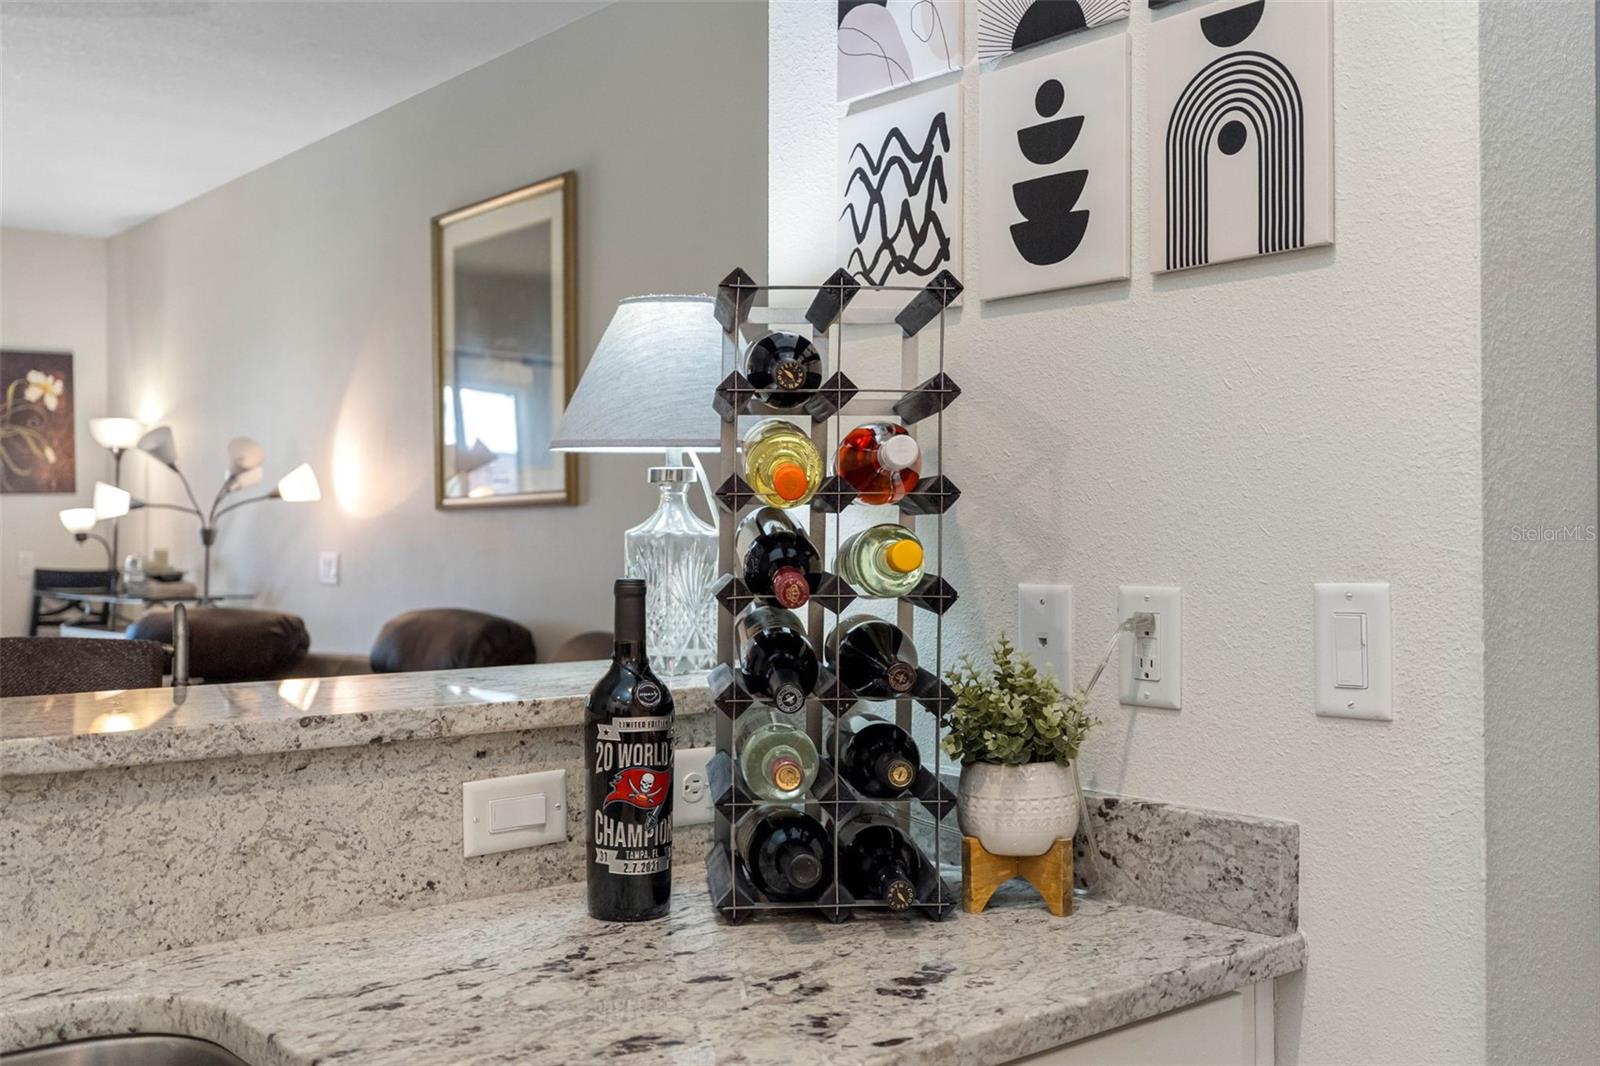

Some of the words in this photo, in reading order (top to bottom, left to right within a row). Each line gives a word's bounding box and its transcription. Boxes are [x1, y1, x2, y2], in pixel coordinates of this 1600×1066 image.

[618, 721, 647, 729] LIMITED
[595, 741, 613, 774] 20
[618, 741, 668, 769] WORLD
[599, 850, 608, 862] 31
[652, 848, 659, 858] FL
[623, 861, 660, 873] 2.7.2021
